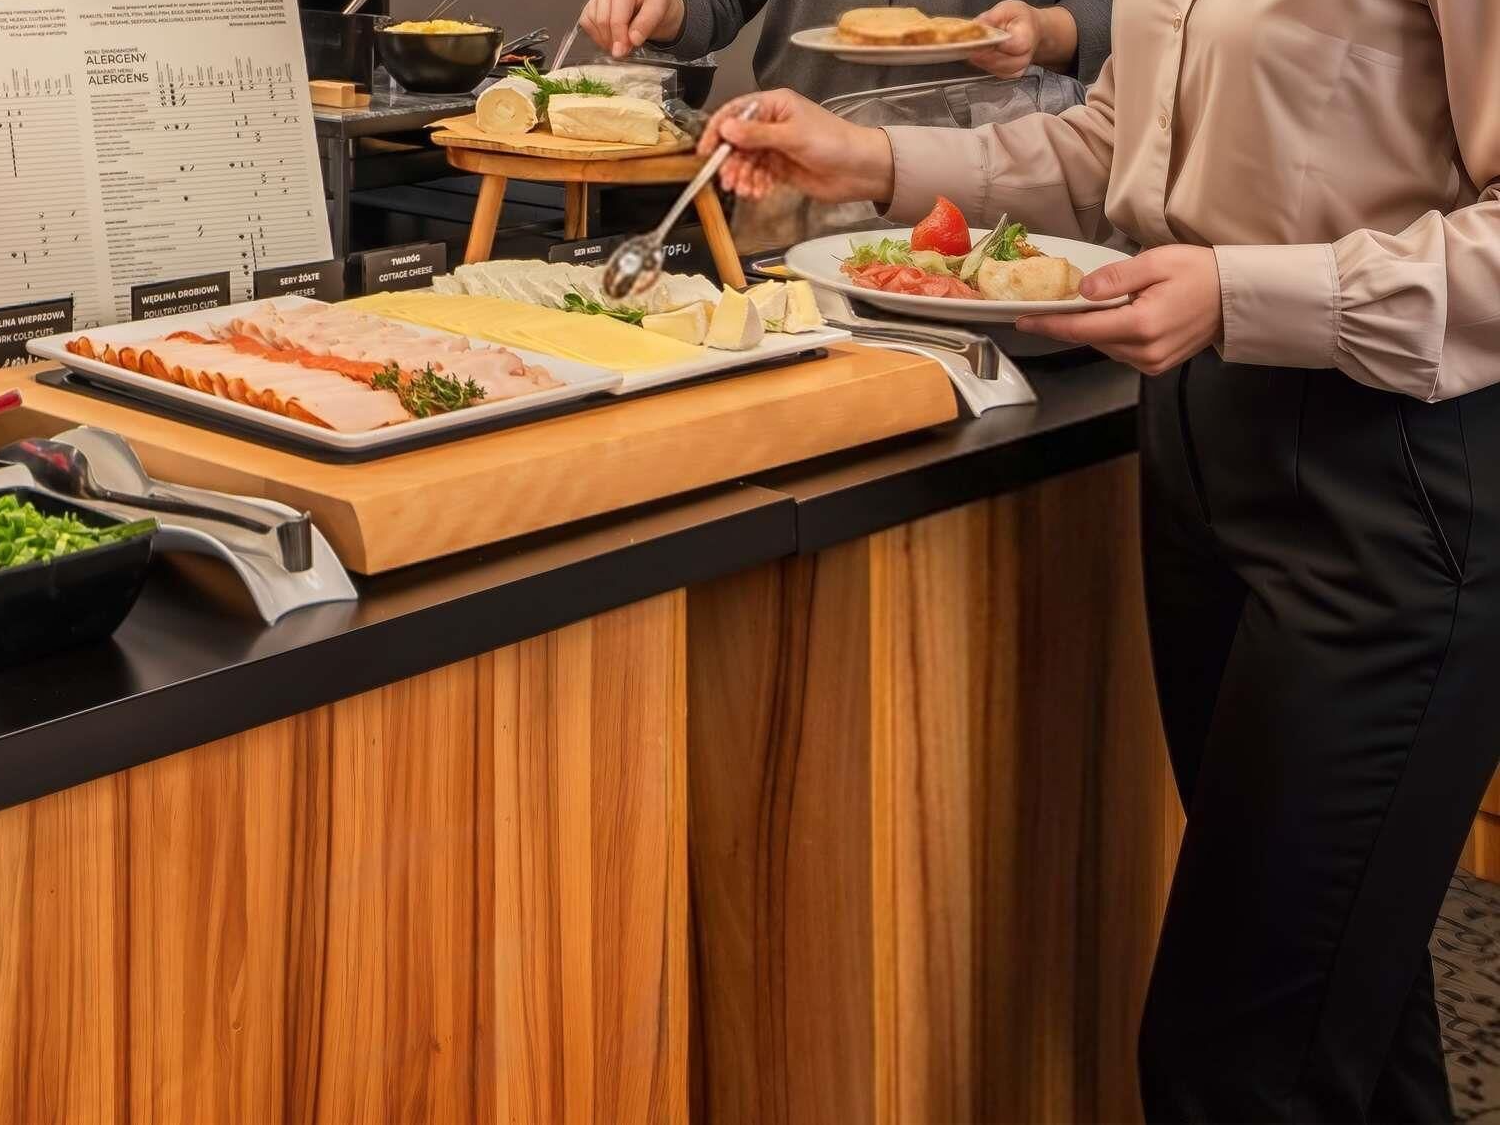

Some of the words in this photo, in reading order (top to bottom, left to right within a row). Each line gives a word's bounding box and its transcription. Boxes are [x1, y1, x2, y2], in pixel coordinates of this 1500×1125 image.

[86, 53, 147, 65] ALERGENY
[88, 73, 149, 85] ALERGENS
[662, 242, 692, 257] TOFU
[390, 253, 420, 266] TWARÓG
[378, 270, 408, 282] COTTAGE
[408, 265, 434, 276] CHEESE
[280, 276, 298, 286] SERY
[141, 291, 177, 305] WĘDLINA
[178, 284, 220, 298] DROBIOWA
[143, 306, 177, 318] POULTRY
[178, 303, 198, 314] COLD
[199, 299, 218, 309] CUTS
[17, 310, 66, 325] WIEPRZOWA
[13, 330, 34, 341] COLD
[35, 327, 54, 338] CUTS
